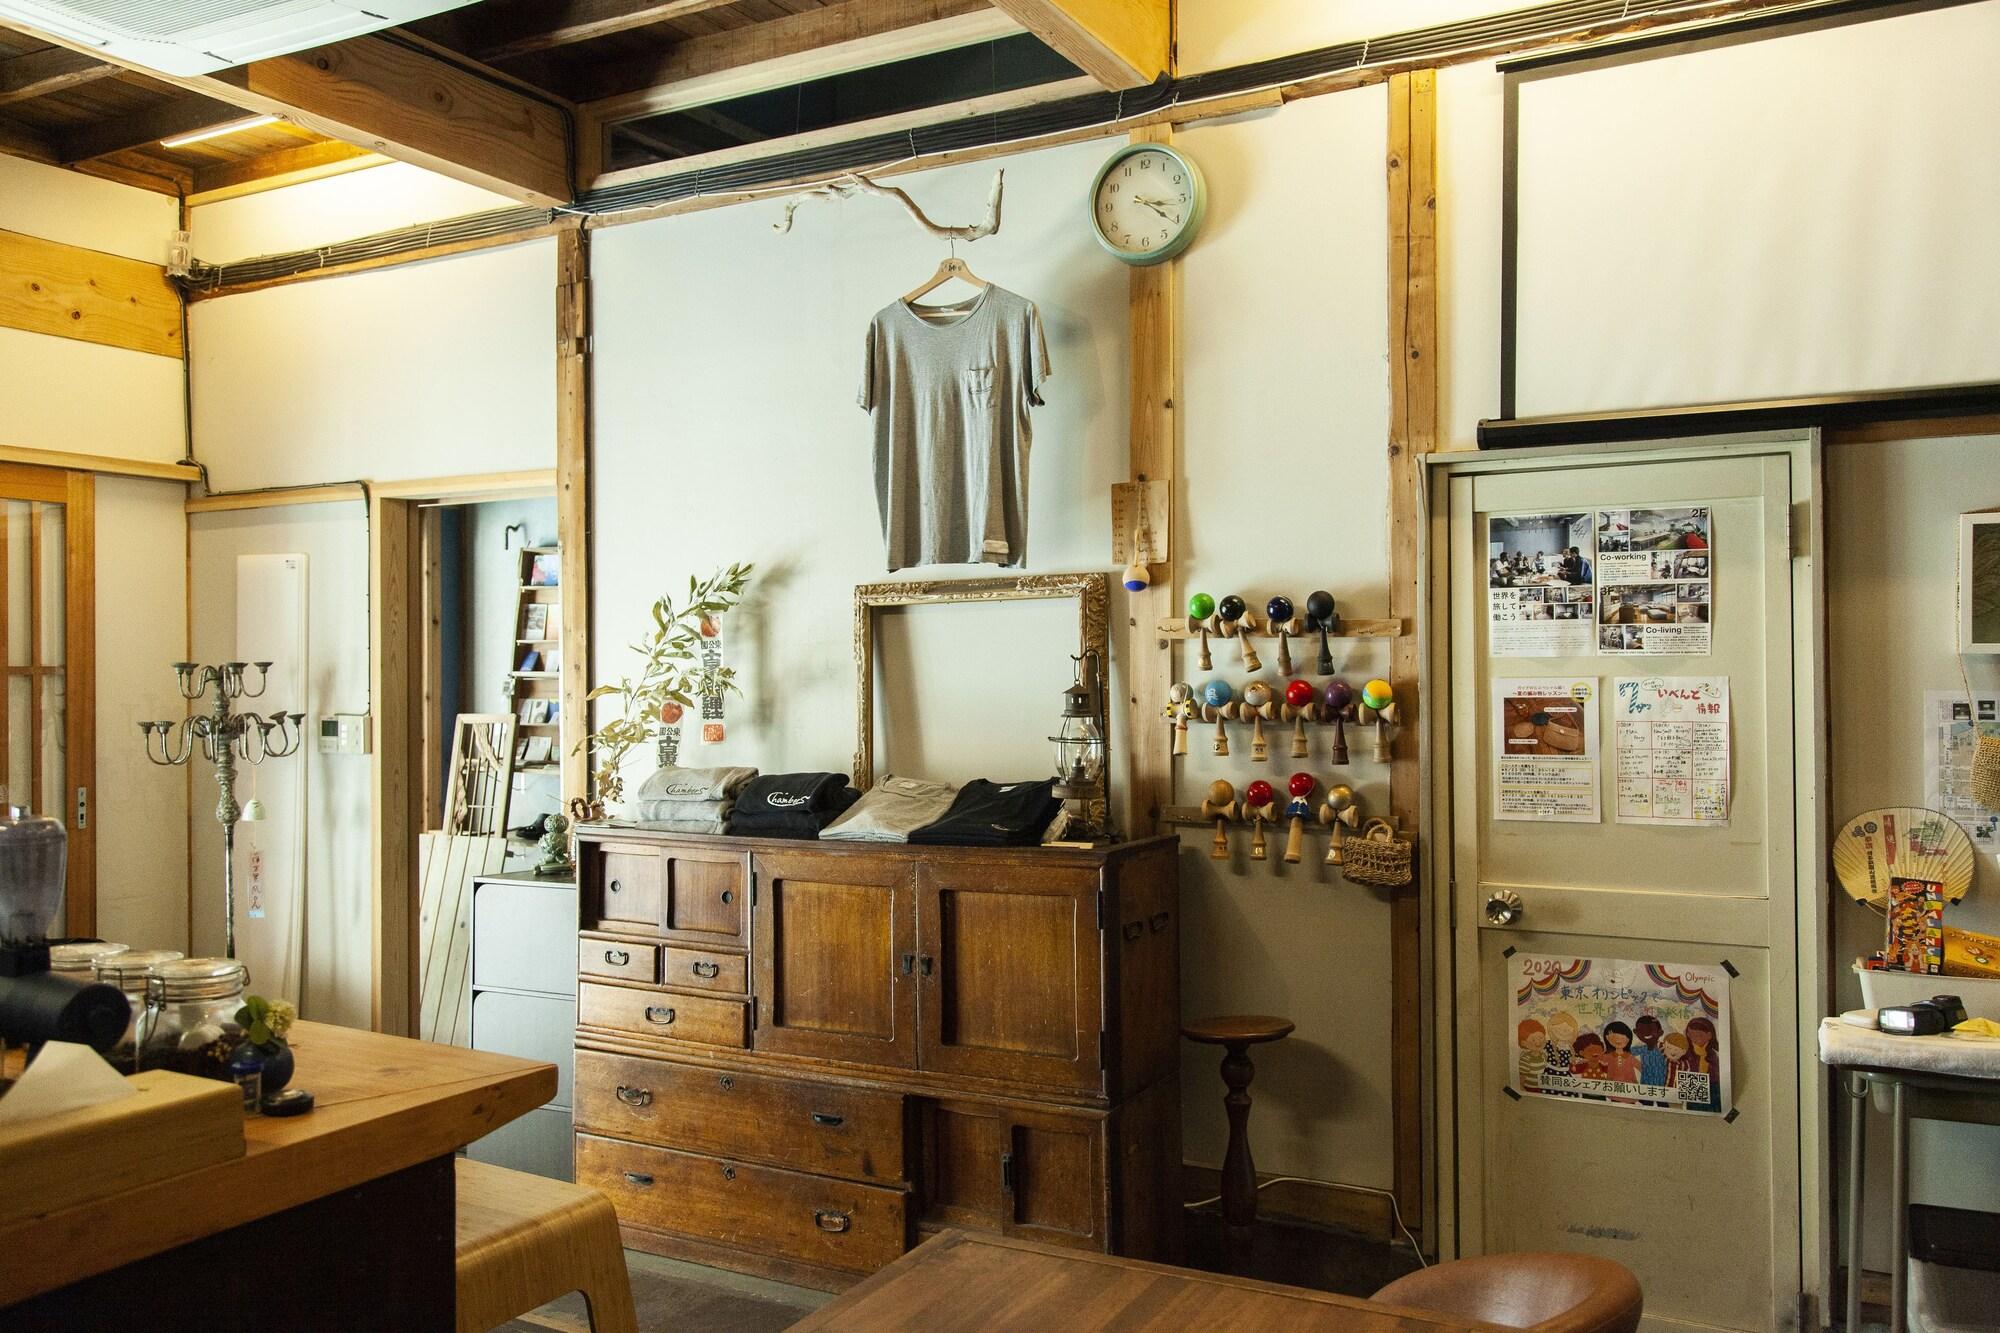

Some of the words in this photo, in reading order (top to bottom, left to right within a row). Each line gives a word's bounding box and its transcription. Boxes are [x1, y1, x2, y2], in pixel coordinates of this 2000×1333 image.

[1140, 159, 1150, 170] 12
[1124, 167, 1132, 177] 11
[1173, 174, 1181, 185] 2
[1109, 183, 1119, 193] 10
[1179, 193, 1186, 203] 3
[1105, 203, 1113, 213] 9
[1110, 222, 1118, 232] 8
[1124, 234, 1131, 244] 7
[1160, 229, 1168, 239] 5
[1141, 237, 1150, 247] 6
[1692, 508, 1706, 518] 2F
[1600, 553, 1647, 561] Co-working
[1493, 592, 1517, 600] 世界を
[1600, 587, 1615, 596] 3F
[1646, 626, 1682, 634] Co-living
[1657, 688, 1701, 700] いべんと
[1696, 702, 1721, 714] 情報
[666, 783, 709, 796] Chambers
[767, 791, 811, 807] Chambers
[1523, 959, 1561, 976] 2020
[1685, 971, 1716, 984] Olympic
